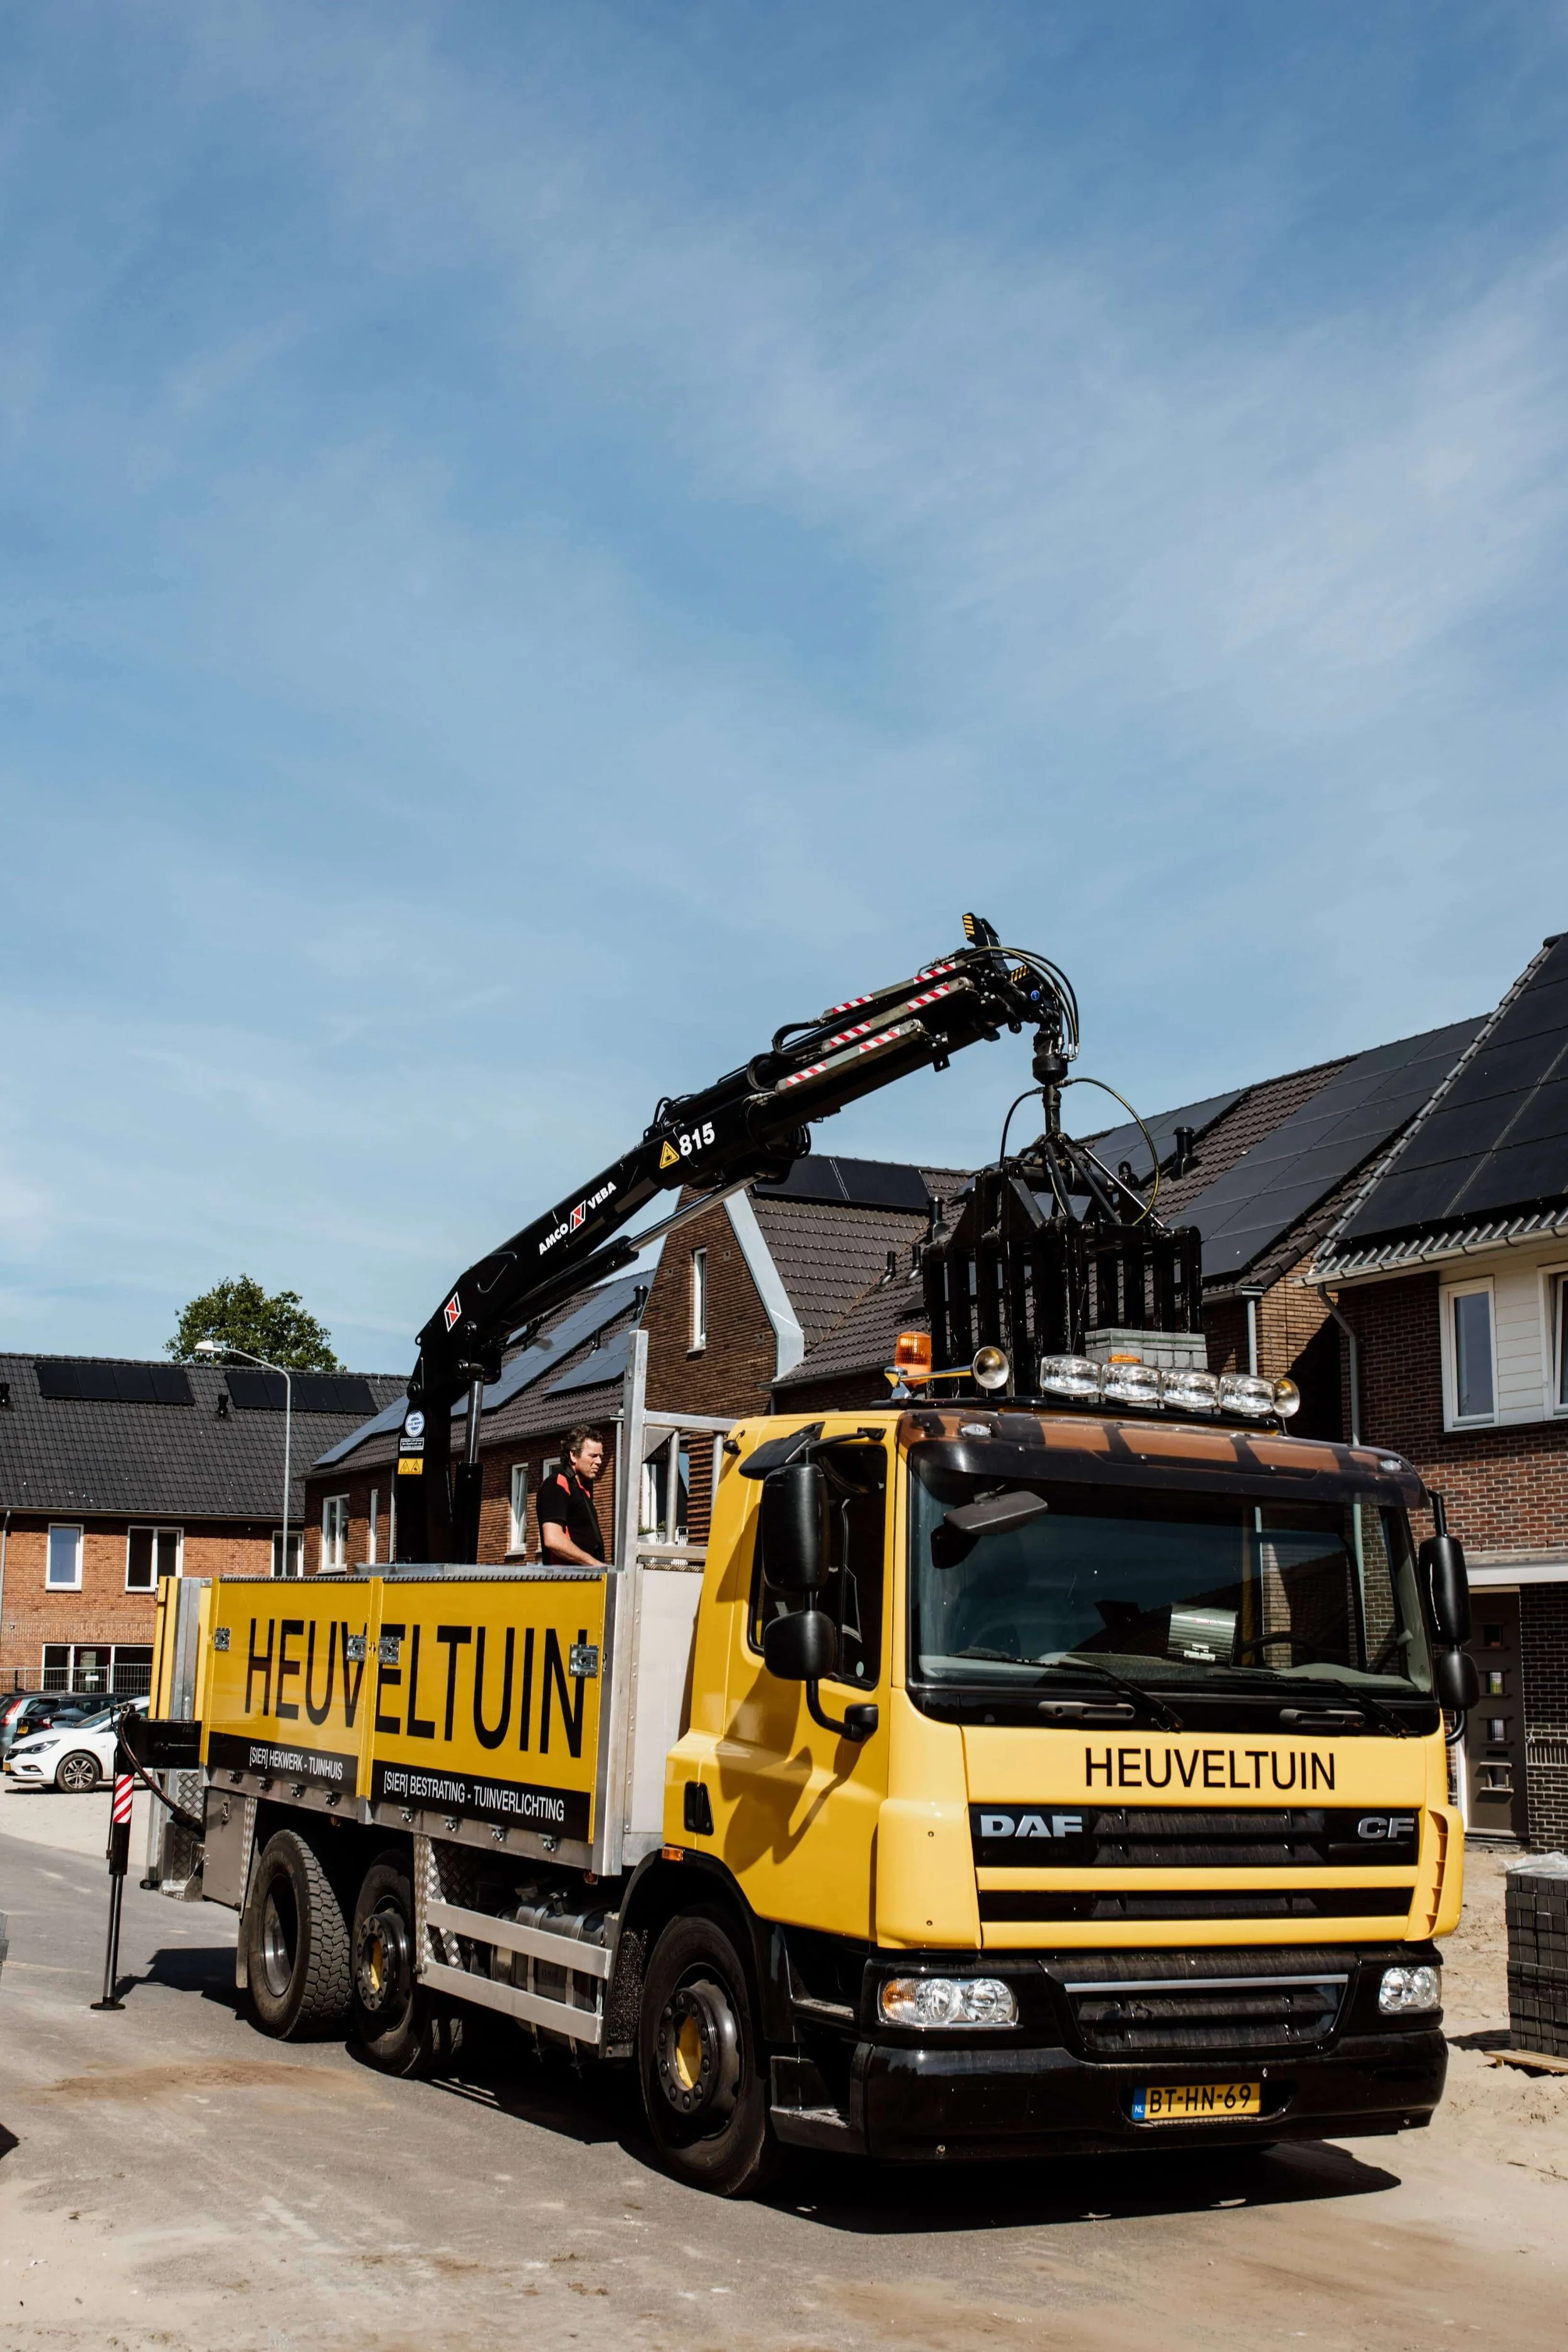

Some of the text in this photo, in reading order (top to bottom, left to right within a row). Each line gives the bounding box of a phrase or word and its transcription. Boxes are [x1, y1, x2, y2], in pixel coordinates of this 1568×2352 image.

[679, 1122, 715, 1156] 815
[538, 1181, 617, 1255] AMCO VEBA
[245, 1618, 587, 1759] HEUVELTUIN
[249, 1746, 268, 1769] [SIER]
[269, 1750, 304, 1772] HEKWERK
[309, 1757, 344, 1780] TUINHUIS
[1085, 1747, 1335, 1791] HEUVELTUIN
[383, 1770, 408, 1797] [SIER]
[410, 1775, 465, 1804] BESTRATING
[474, 1785, 564, 1822] TUINVERLICHTING
[980, 1814, 1083, 1838] DAF
[1358, 1817, 1414, 1839] CF
[1150, 2085, 1251, 2114] BT-HN-69
